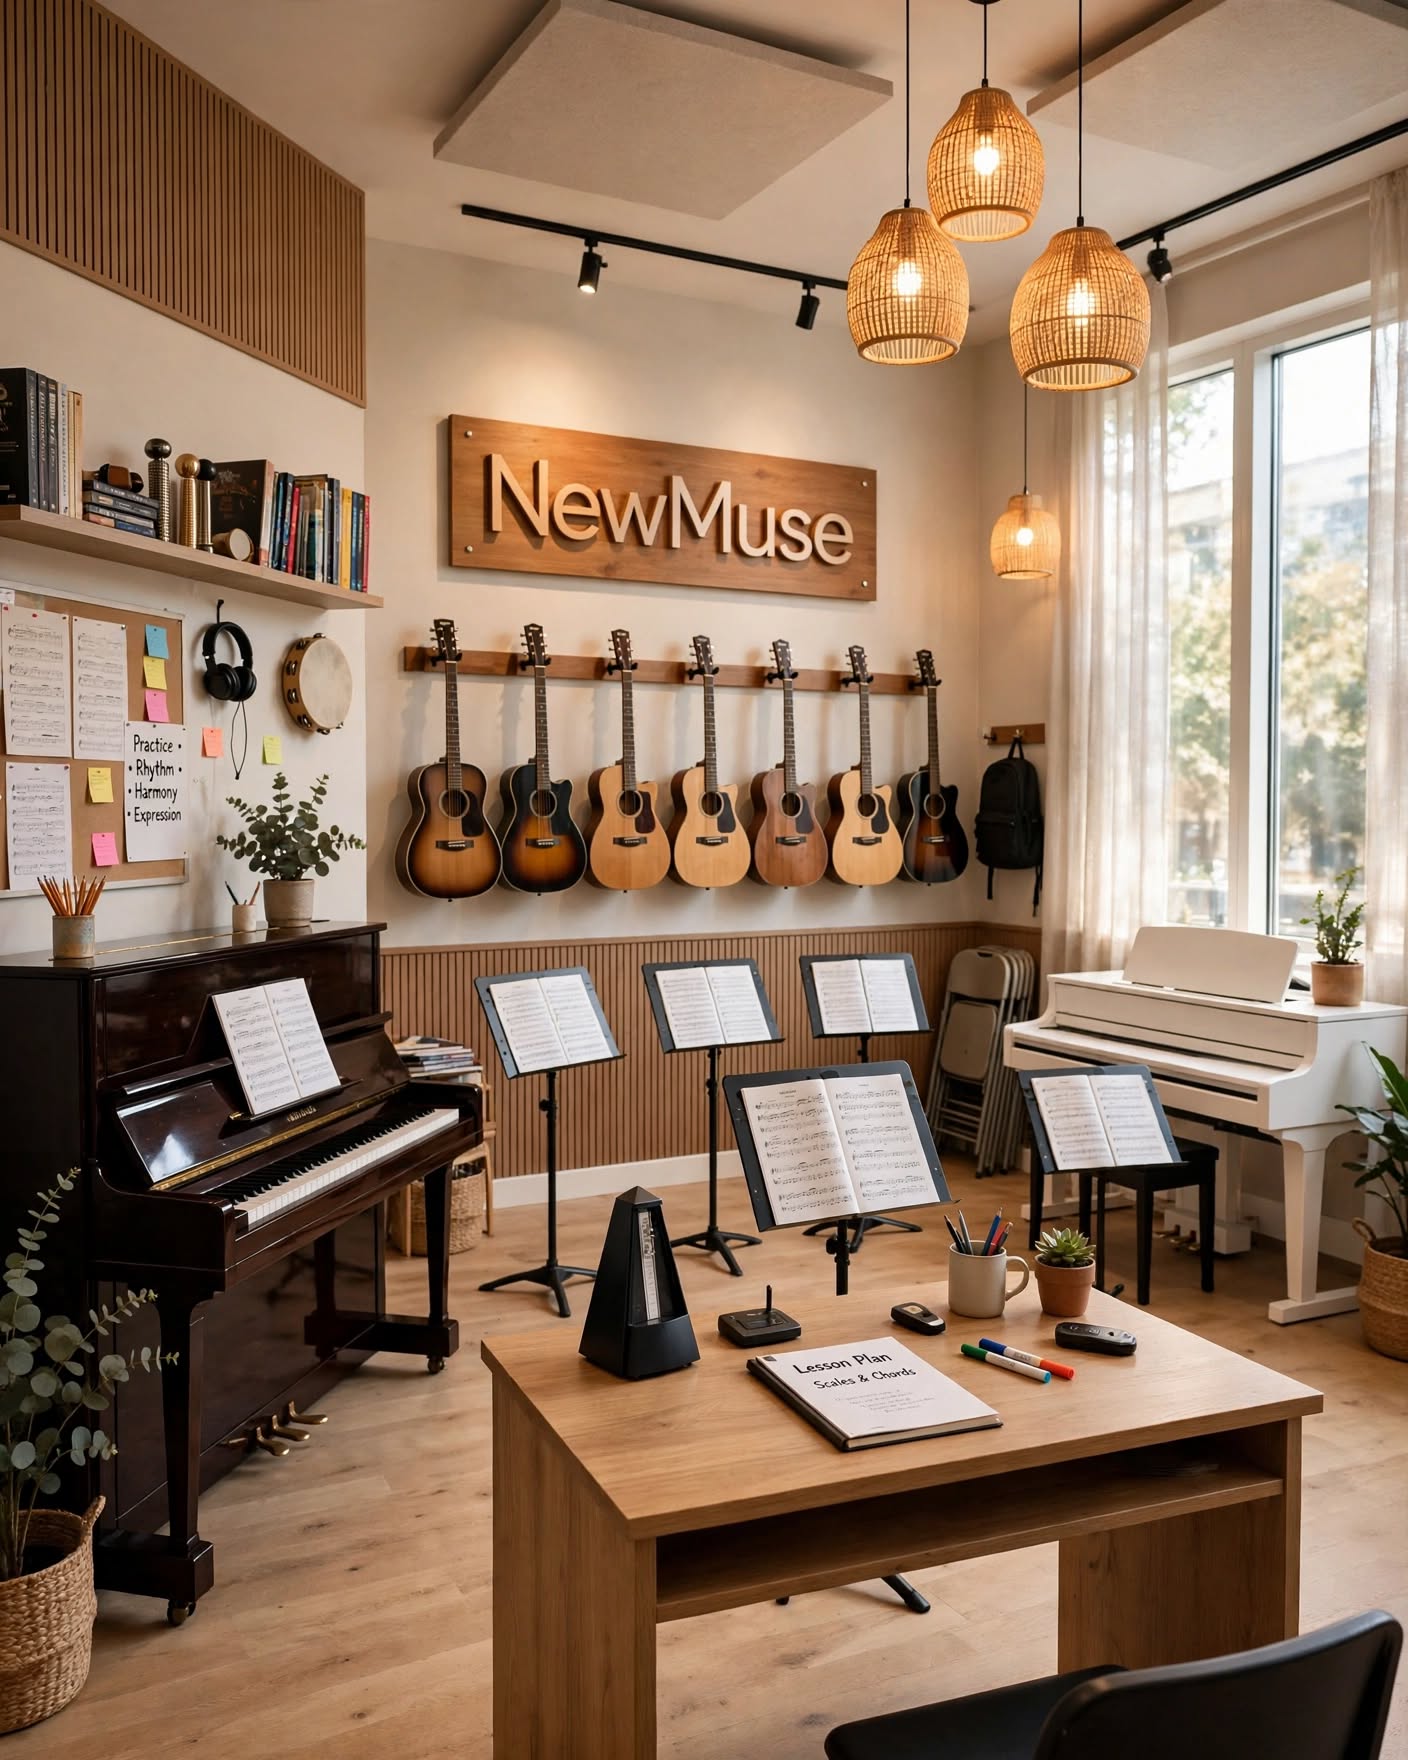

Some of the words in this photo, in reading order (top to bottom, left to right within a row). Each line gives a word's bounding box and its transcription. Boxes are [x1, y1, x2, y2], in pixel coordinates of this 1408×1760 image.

[487, 453, 854, 565] NewMuse
[133, 734, 174, 753] Practice
[136, 759, 175, 782] Rhythm
[134, 782, 178, 804] Harmony
[133, 806, 182, 827] Expression
[792, 1359, 852, 1374] Lesson
[852, 1352, 893, 1366] Plan
[813, 1377, 856, 1390] Scales
[857, 1374, 870, 1383] &
[871, 1367, 917, 1380] Chords
